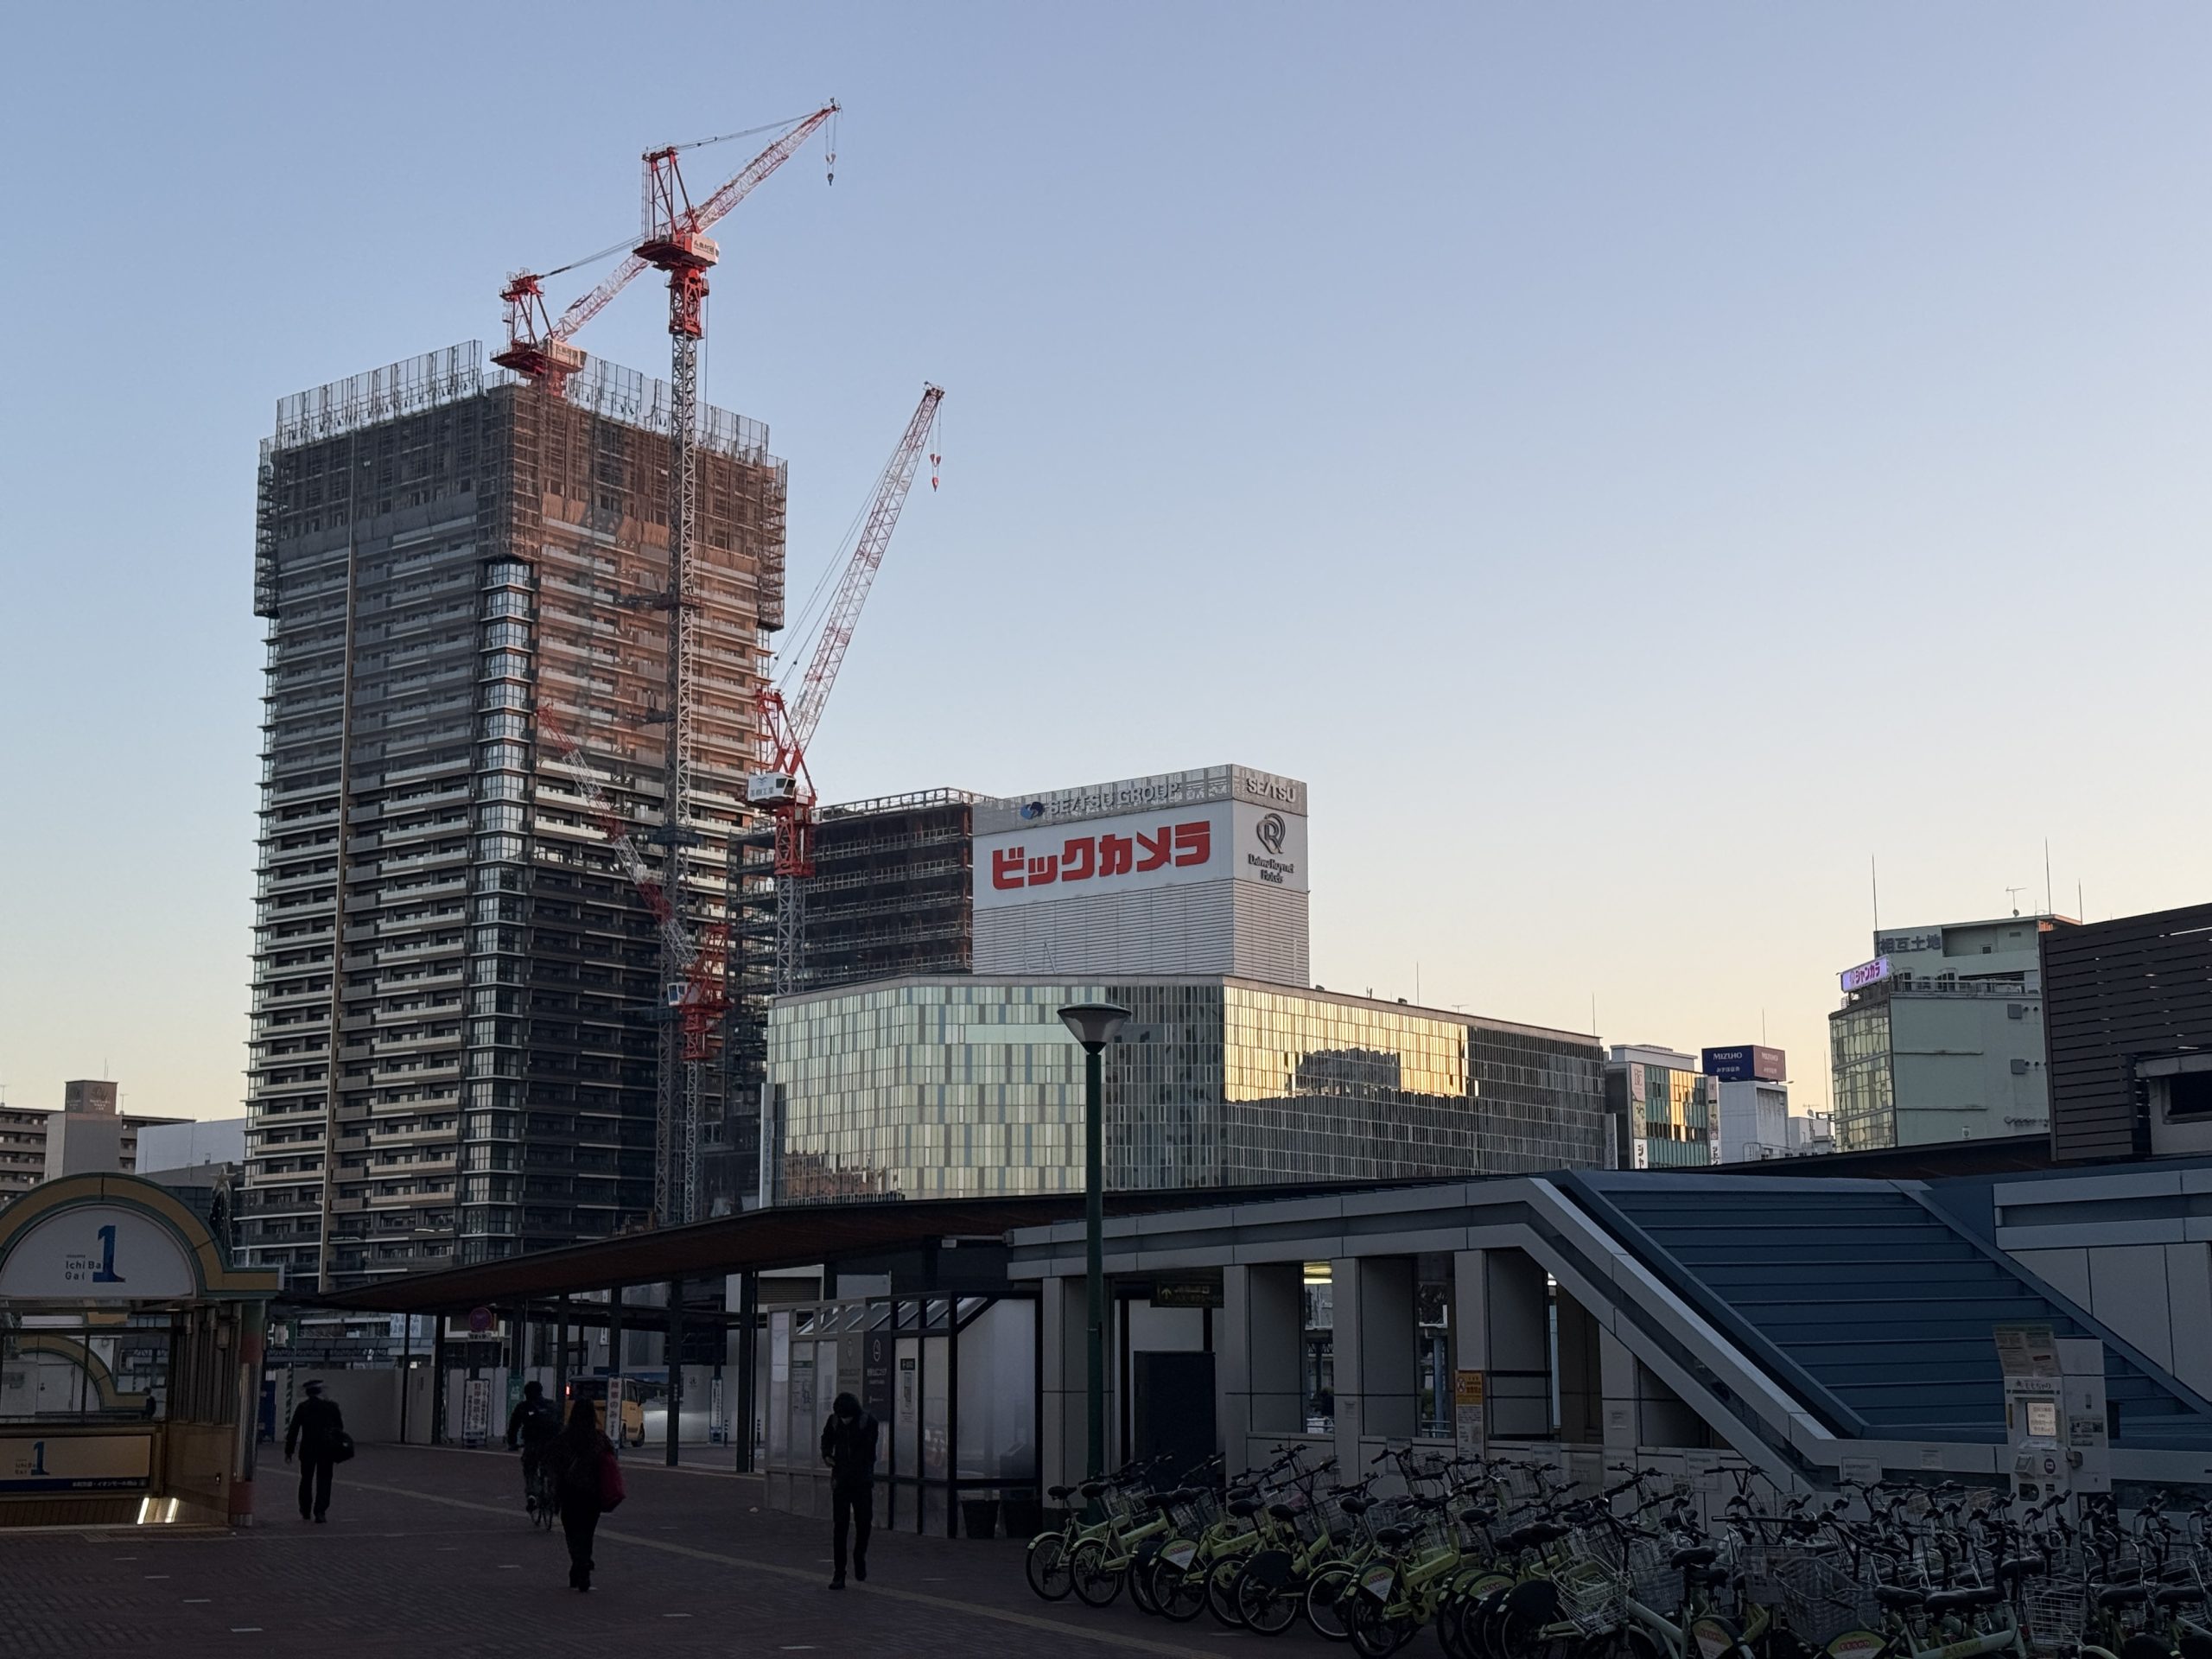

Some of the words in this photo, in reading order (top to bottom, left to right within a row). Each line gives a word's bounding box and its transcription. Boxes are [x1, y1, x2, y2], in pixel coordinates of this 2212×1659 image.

[1119, 783, 1181, 805] GROUP
[993, 821, 1210, 890] ビックカメラ
[1855, 962, 1881, 984] ジャンカラ
[66, 1261, 86, 1269] Ichi
[92, 1225, 126, 1283] 1
[30, 1441, 50, 1476] 1
